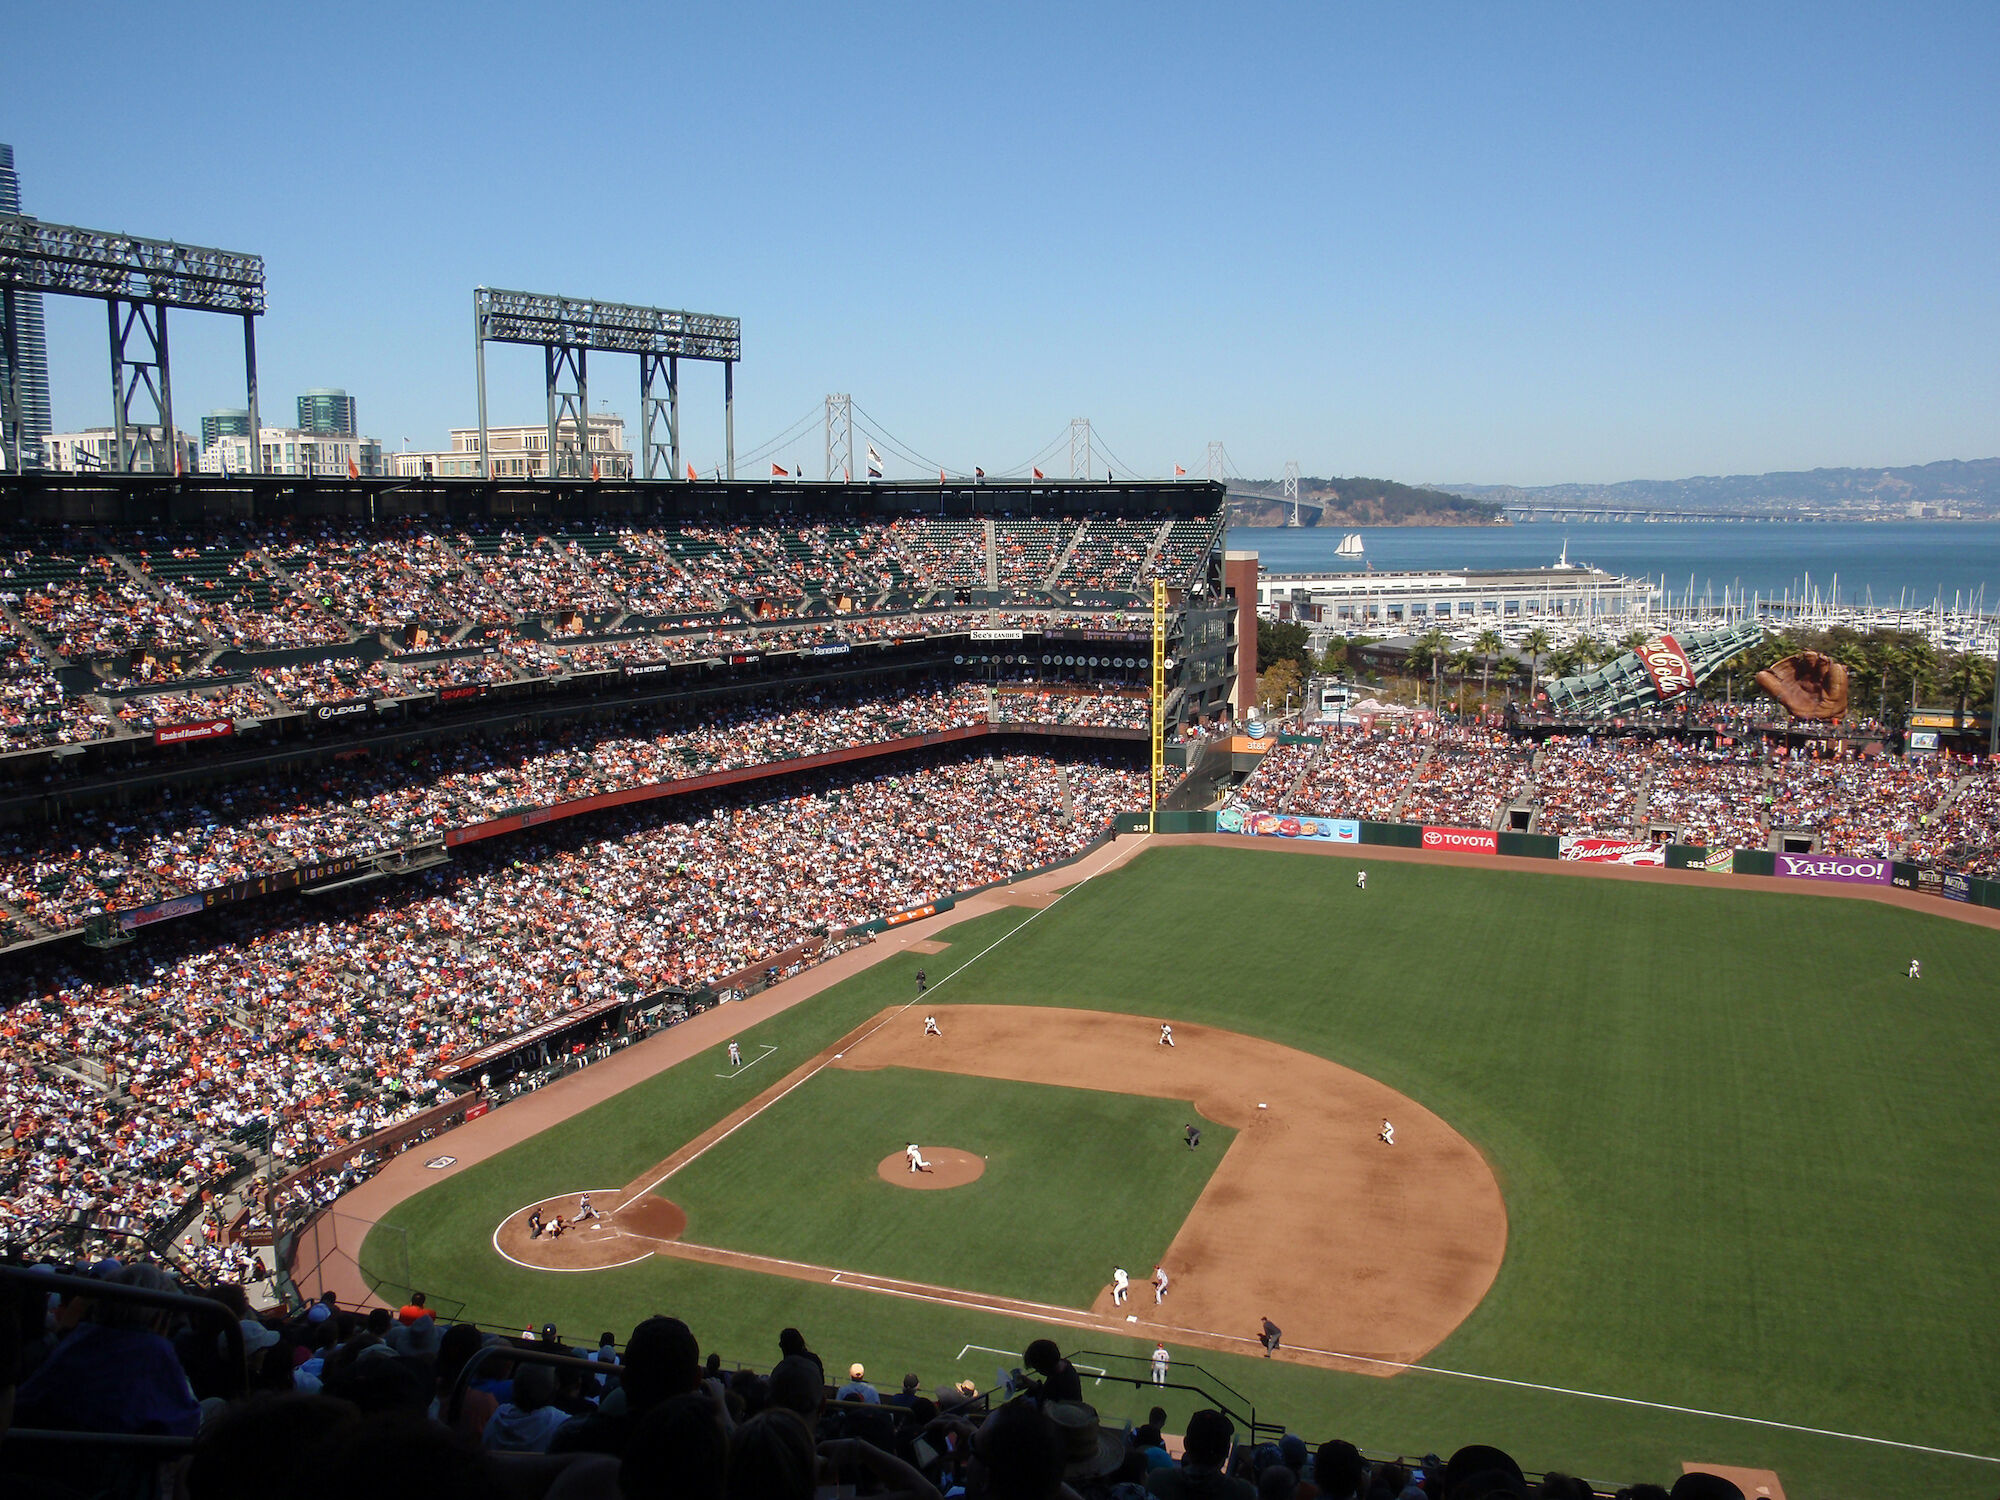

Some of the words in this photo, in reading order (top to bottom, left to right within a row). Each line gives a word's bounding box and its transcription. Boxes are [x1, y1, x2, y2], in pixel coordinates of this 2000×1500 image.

[972, 631, 992, 639] See's
[813, 644, 849, 656] Genentech
[441, 688, 477, 699] SHARP
[331, 704, 366, 715] LEXUS
[160, 731, 178, 741] Bank
[184, 727, 212, 738] America
[1247, 741, 1266, 750] at&t
[1444, 834, 1495, 848] TOYOTA
[1562, 840, 1653, 861] Budweiser
[1704, 849, 1734, 865] EMERALD
[1686, 860, 1705, 869] 382
[1779, 856, 1885, 880] YAHOO!
[1892, 877, 1910, 887] 404
